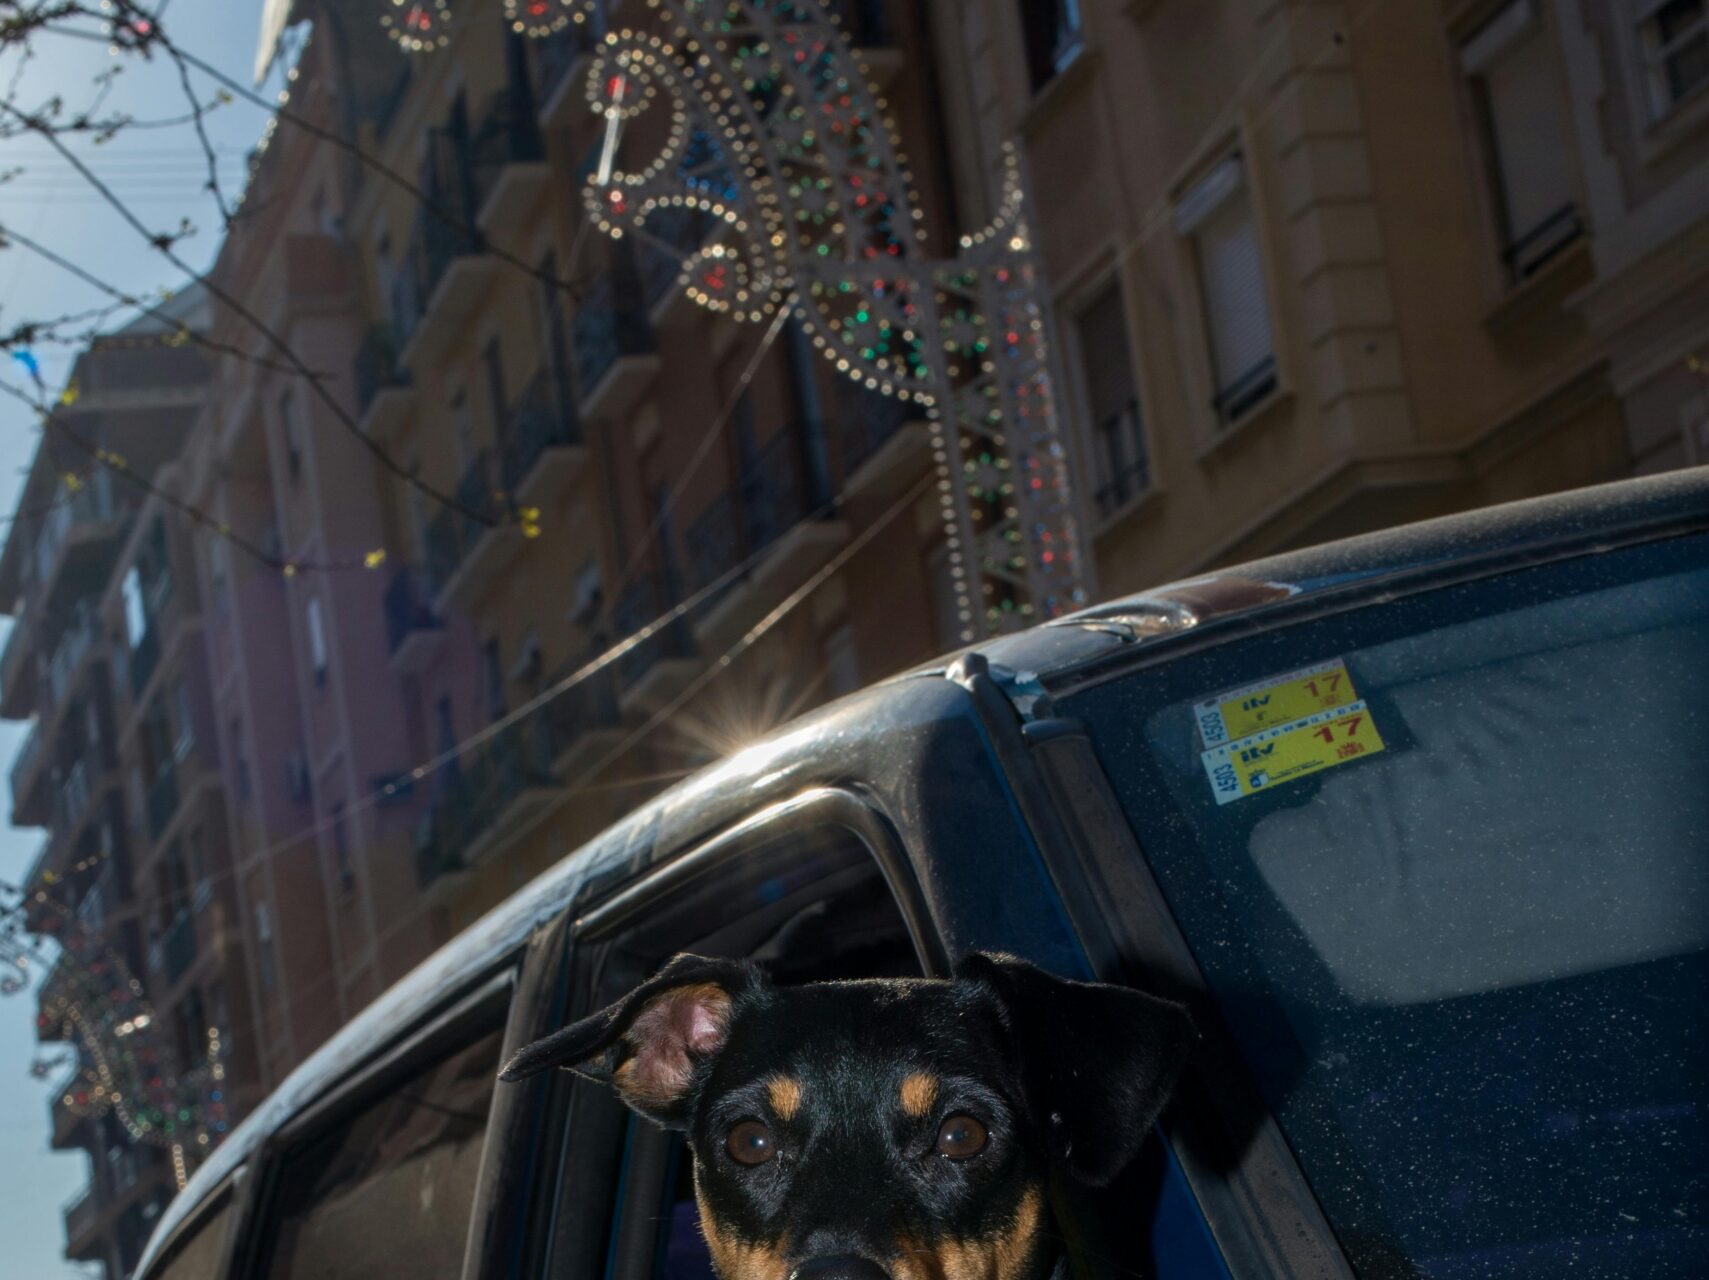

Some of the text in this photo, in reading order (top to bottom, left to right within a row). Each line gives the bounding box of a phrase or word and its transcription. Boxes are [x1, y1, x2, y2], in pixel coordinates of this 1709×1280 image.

[1304, 672, 1341, 697] 17
[1200, 712, 1225, 742] 4503
[1313, 717, 1362, 744] 17
[1213, 763, 1240, 793] 4503
